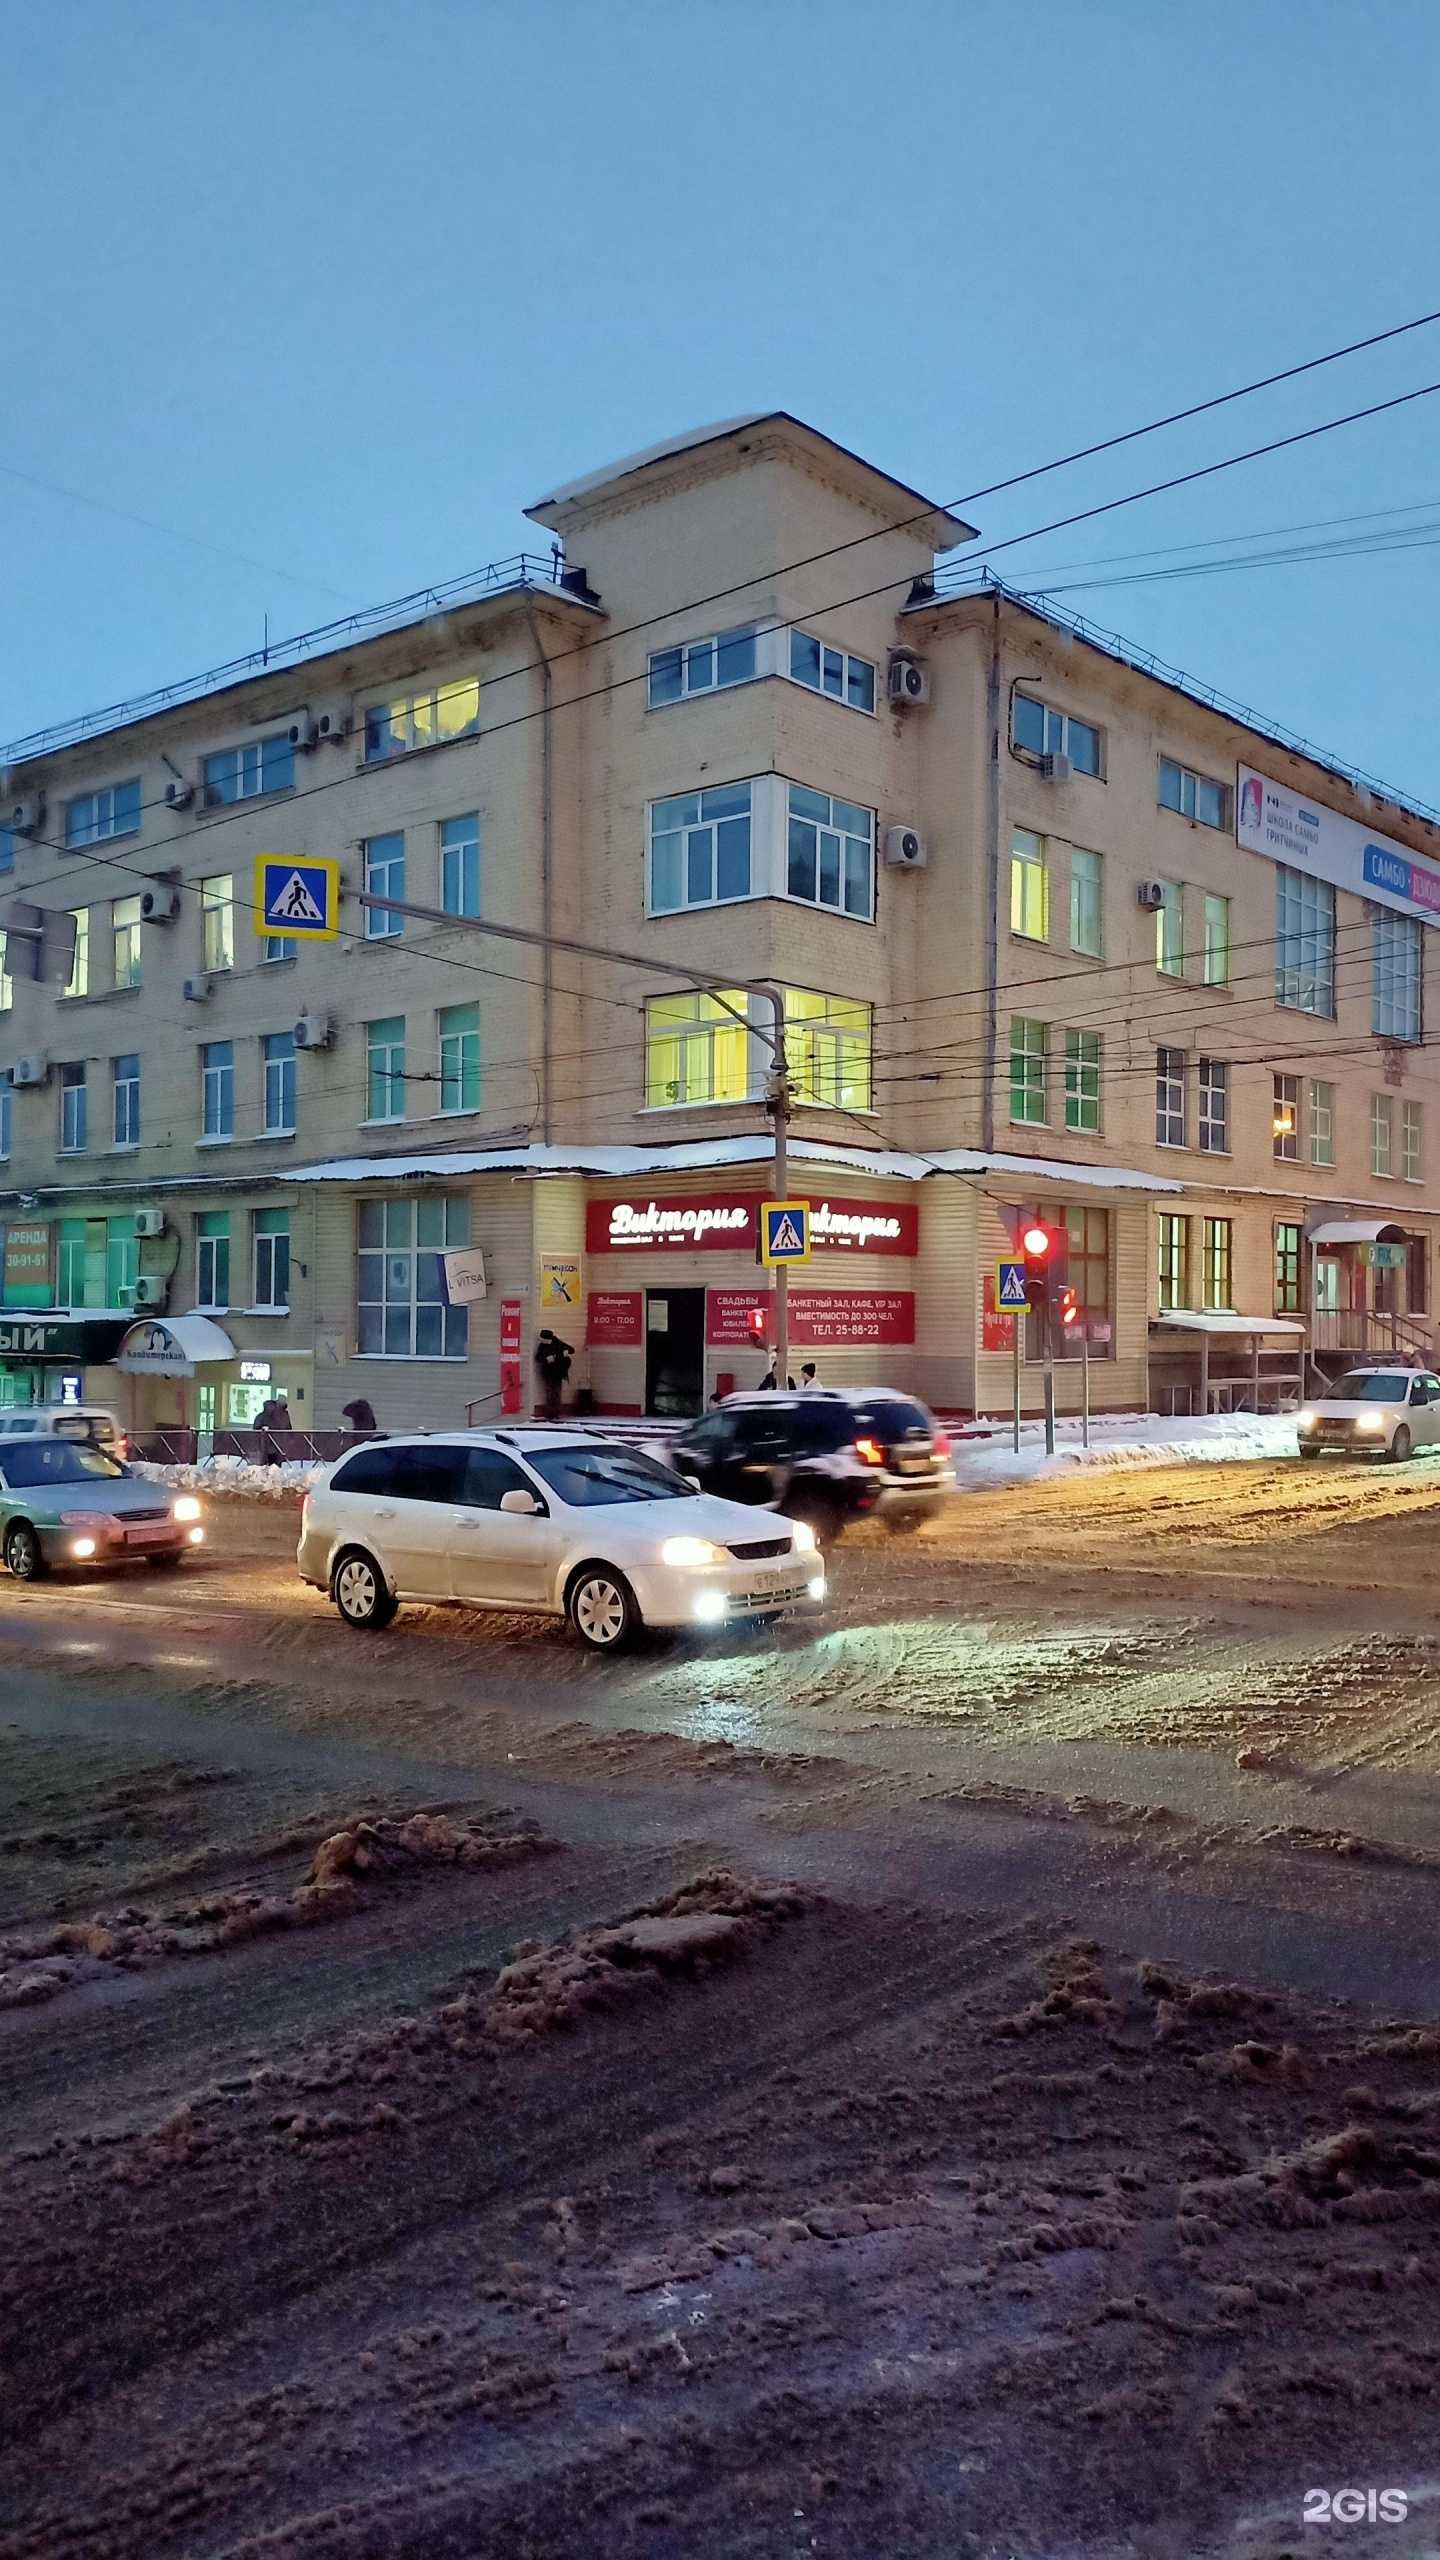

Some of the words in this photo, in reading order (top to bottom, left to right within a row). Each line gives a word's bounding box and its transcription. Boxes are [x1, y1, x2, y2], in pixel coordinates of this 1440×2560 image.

[1372, 854, 1406, 890] САМБО
[608, 1201, 750, 1241] Виктория
[808, 1203, 901, 1246] иктория
[8, 1231, 47, 1245] АРЕНДА
[716, 1297, 759, 1306] СВАДЬБЫ
[787, 1297, 832, 1308] БАНКЕТНЫЙ
[875, 1300, 886, 1309] VIP
[887, 1301, 902, 1309] ЗАЛ
[721, 1309, 748, 1317] БАНКЕТ
[795, 1311, 849, 1321] ВМЕСТИМОСТЬ
[850, 1312, 861, 1322] ДО
[862, 1312, 877, 1320] 300
[812, 1324, 833, 1336] ТЕЛ.
[835, 1324, 880, 1336] 25-88-22
